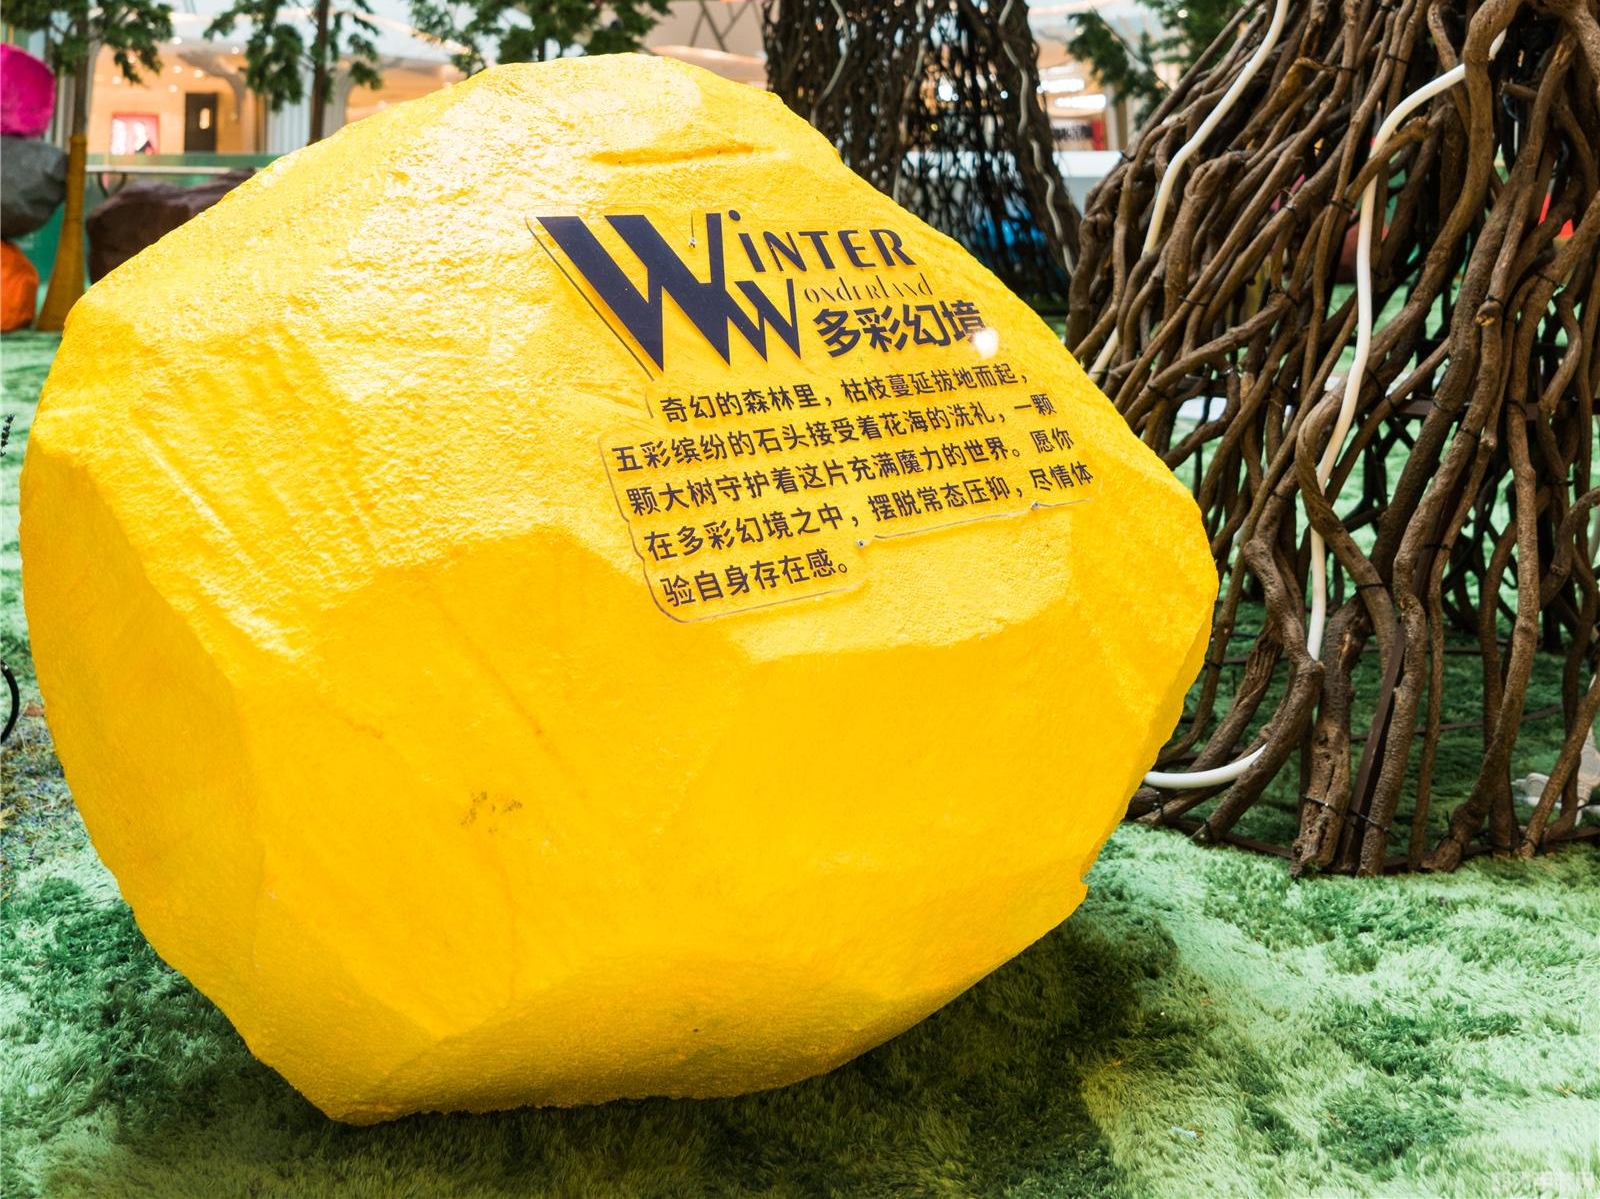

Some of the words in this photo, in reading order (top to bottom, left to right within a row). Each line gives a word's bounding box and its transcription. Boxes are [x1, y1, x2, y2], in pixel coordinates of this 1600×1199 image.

[813, 299, 987, 358] 多彩幻境
[660, 363, 1027, 423] 奇幻的森林里，枯枝蔓延拔地而起，
[612, 393, 1057, 472] 五彩缤纷的石头接受着花海的洗礼，一颗
[644, 461, 1094, 561] 在多彩幻境之中，摆脱常态压抑，尽情体
[660, 548, 848, 607] 验自身存在感。
